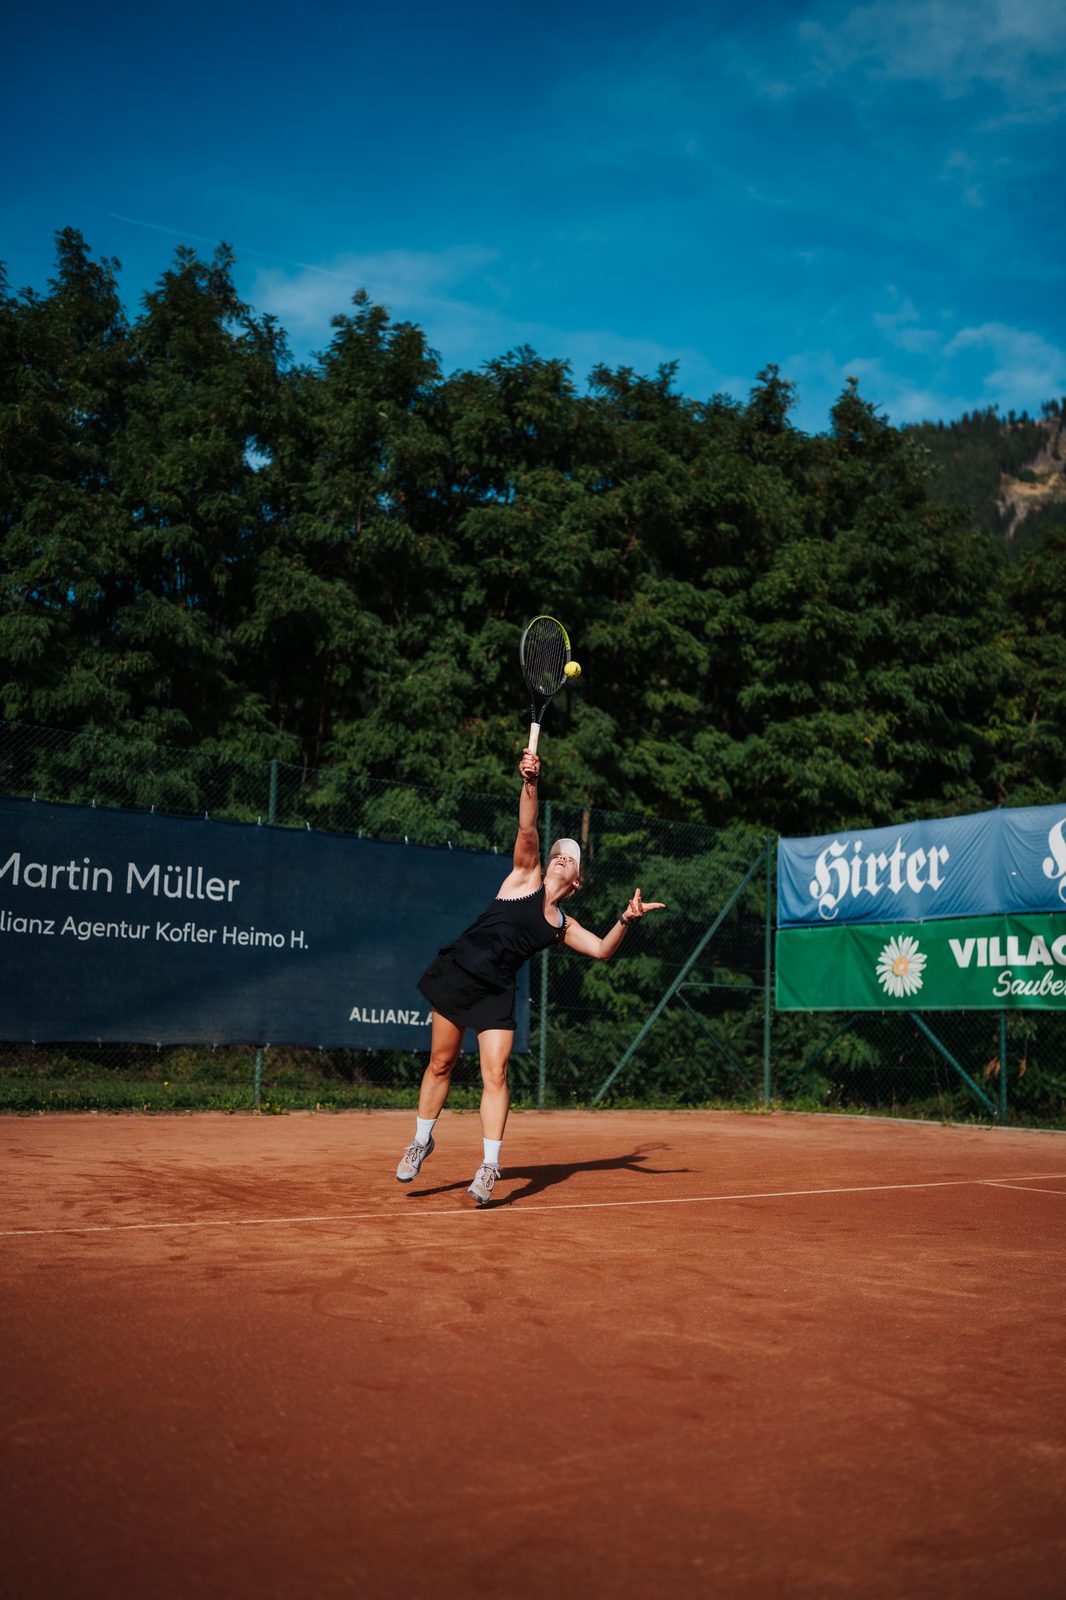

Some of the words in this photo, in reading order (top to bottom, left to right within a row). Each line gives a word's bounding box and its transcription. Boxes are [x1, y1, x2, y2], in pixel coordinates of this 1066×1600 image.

[0, 852, 113, 893] Martin
[126, 862, 241, 902] Müller
[810, 837, 949, 920] Hirter
[60, 916, 150, 941] Agentur
[155, 921, 217, 944] Kofler
[222, 926, 285, 948] Heimo
[290, 930, 309, 949] H.
[992, 969, 1066, 997] Saube
